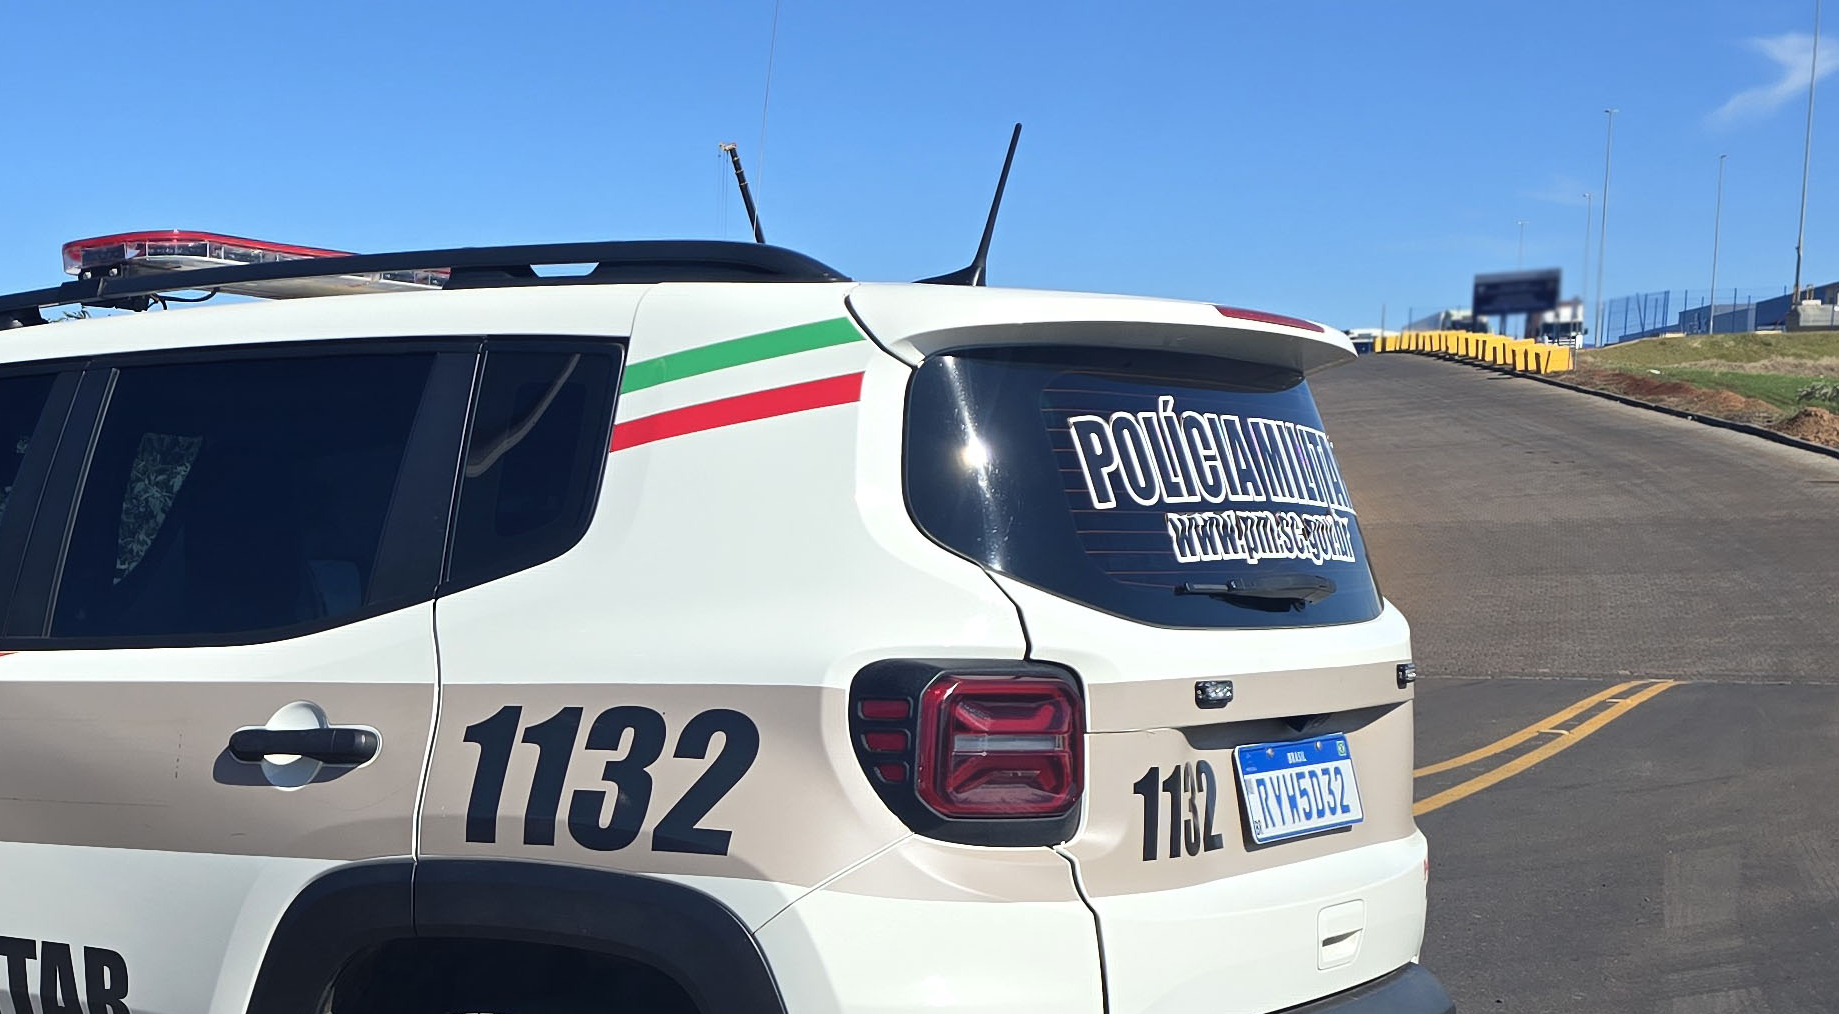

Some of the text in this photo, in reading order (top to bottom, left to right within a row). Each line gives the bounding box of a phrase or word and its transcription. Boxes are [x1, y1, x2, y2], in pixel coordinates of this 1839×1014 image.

[1068, 395, 1265, 510] POLÍCIA
[1164, 510, 1355, 565] www.pm.sc.gov.br
[462, 704, 761, 857] 1132
[1132, 759, 1224, 862] 1132
